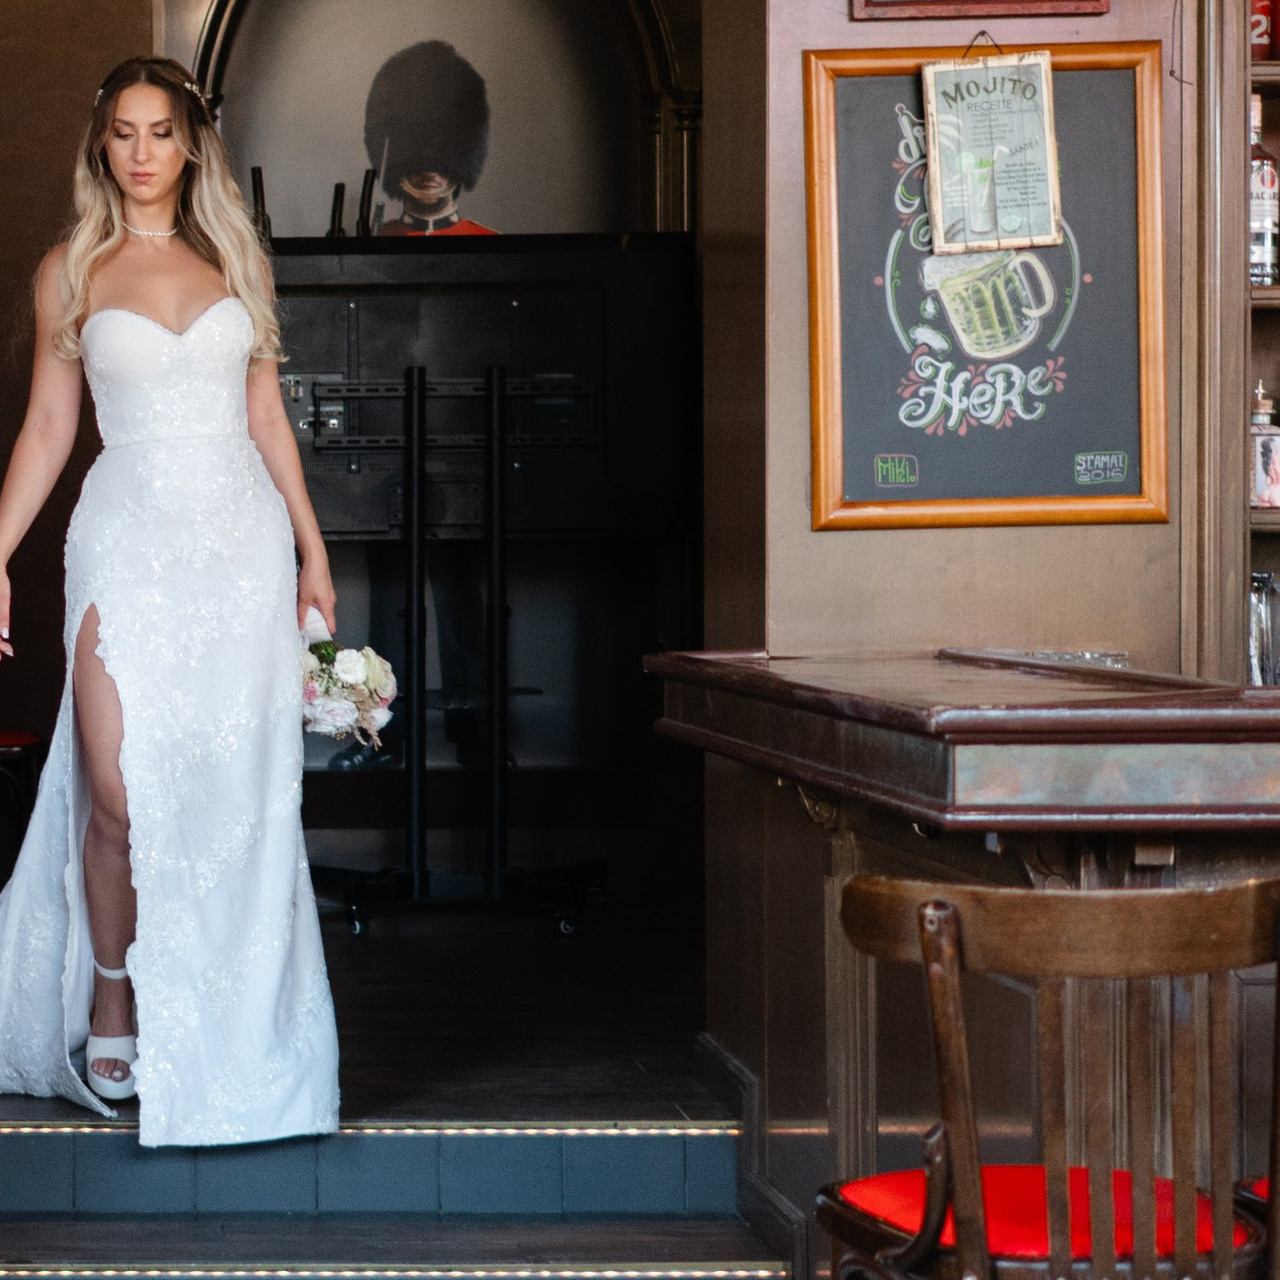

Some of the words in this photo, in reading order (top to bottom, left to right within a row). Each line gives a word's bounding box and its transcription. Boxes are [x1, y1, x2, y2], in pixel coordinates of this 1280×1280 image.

[940, 75, 1038, 110] MOJITO
[966, 99, 1014, 113] RECETTE
[1078, 468, 1123, 481] 2016
